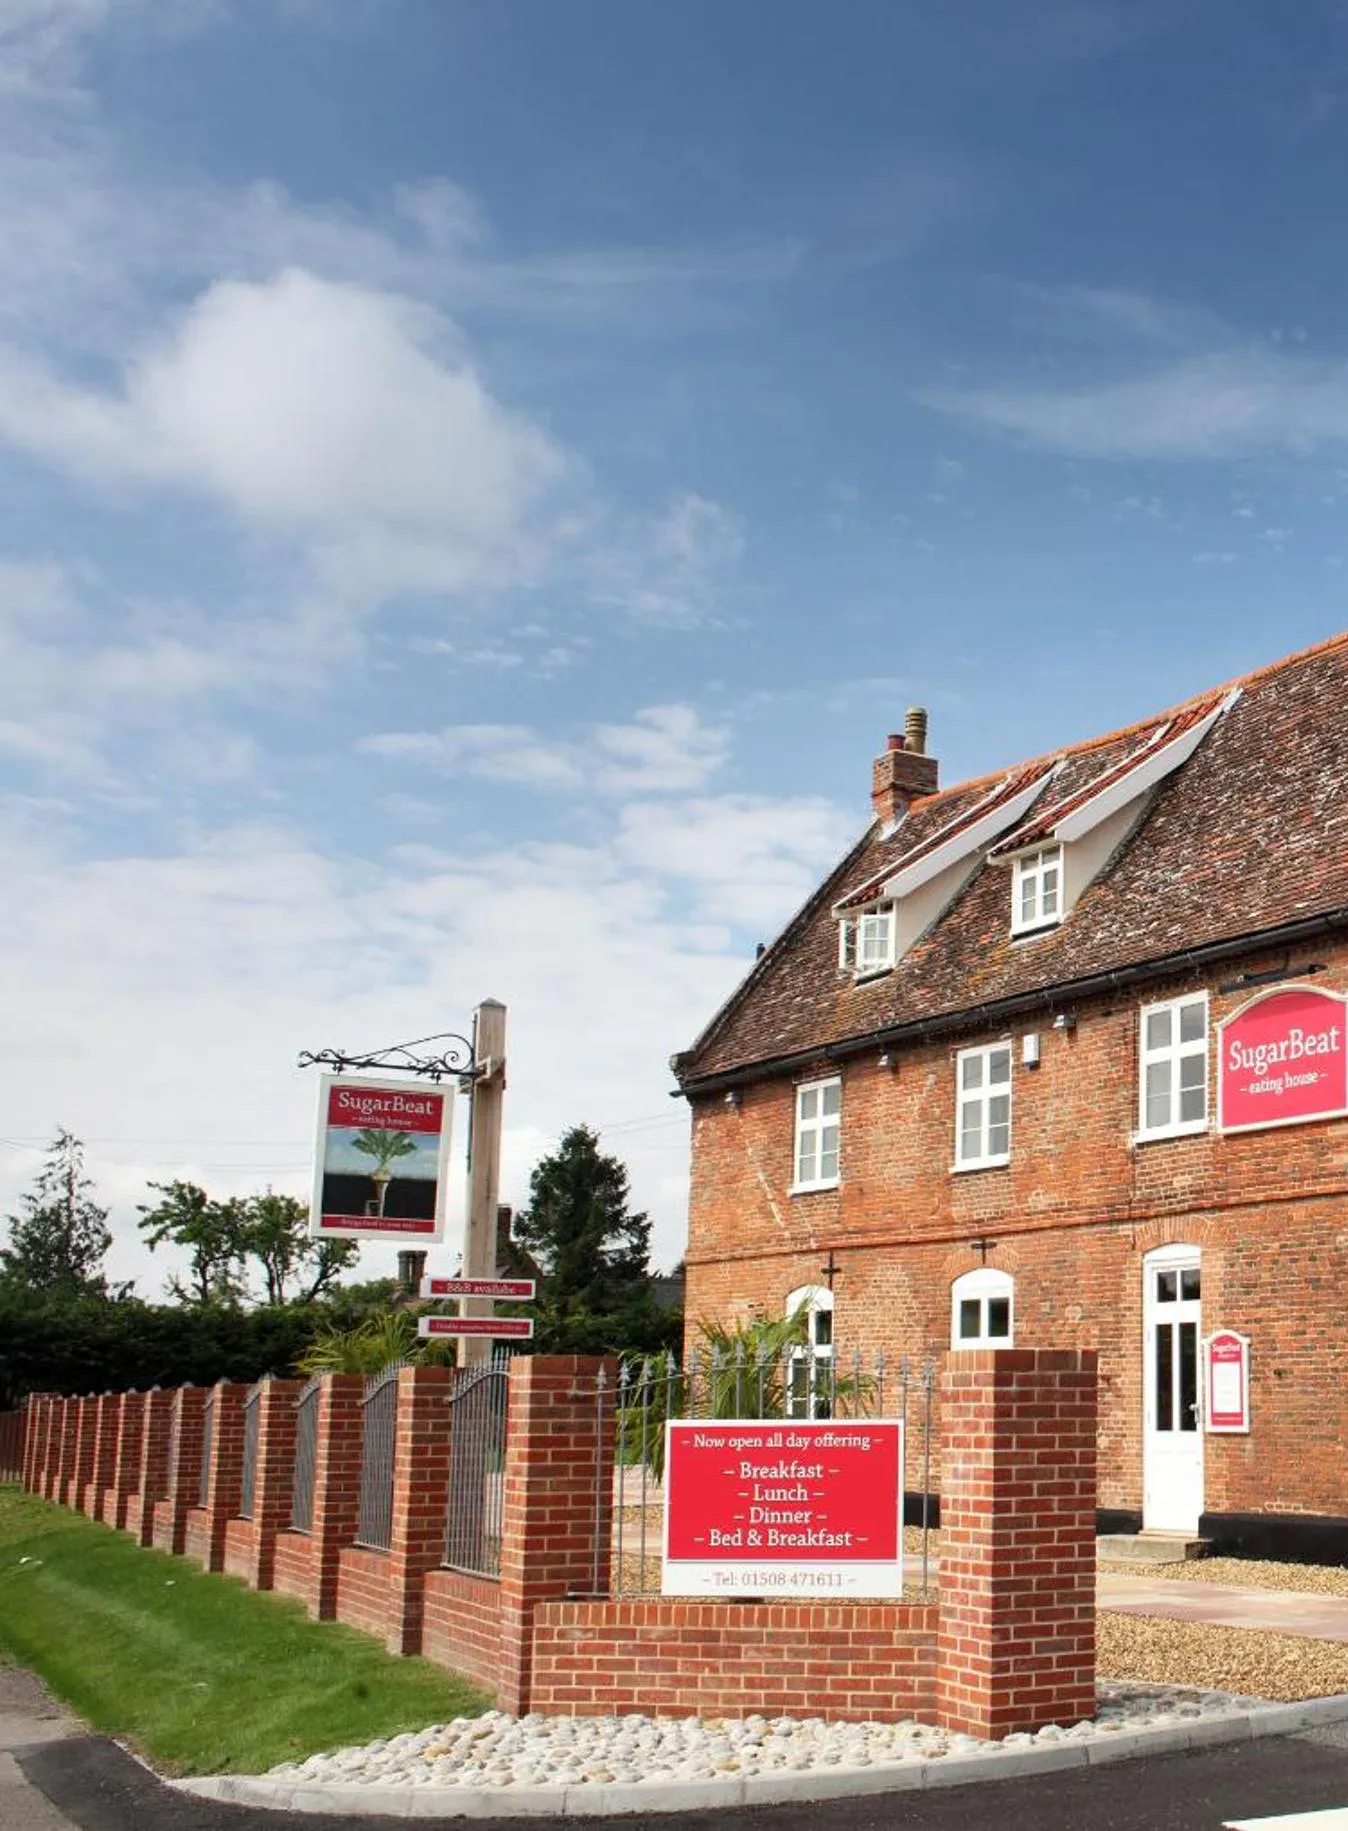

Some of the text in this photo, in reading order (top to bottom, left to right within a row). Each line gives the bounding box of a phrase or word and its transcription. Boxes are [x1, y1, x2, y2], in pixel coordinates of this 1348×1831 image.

[1229, 1025, 1341, 1076] SugarBeat
[1249, 1071, 1319, 1096] eating house
[337, 1091, 435, 1116] SugarBeat
[693, 1432, 871, 1452] Now open all day offering
[739, 1460, 824, 1480] Breakfast
[753, 1483, 809, 1502] Lunch
[749, 1506, 812, 1524] Dinner
[709, 1528, 853, 1547] Bed & Breakfast
[714, 1572, 843, 1587] Tel: 01508 471611
